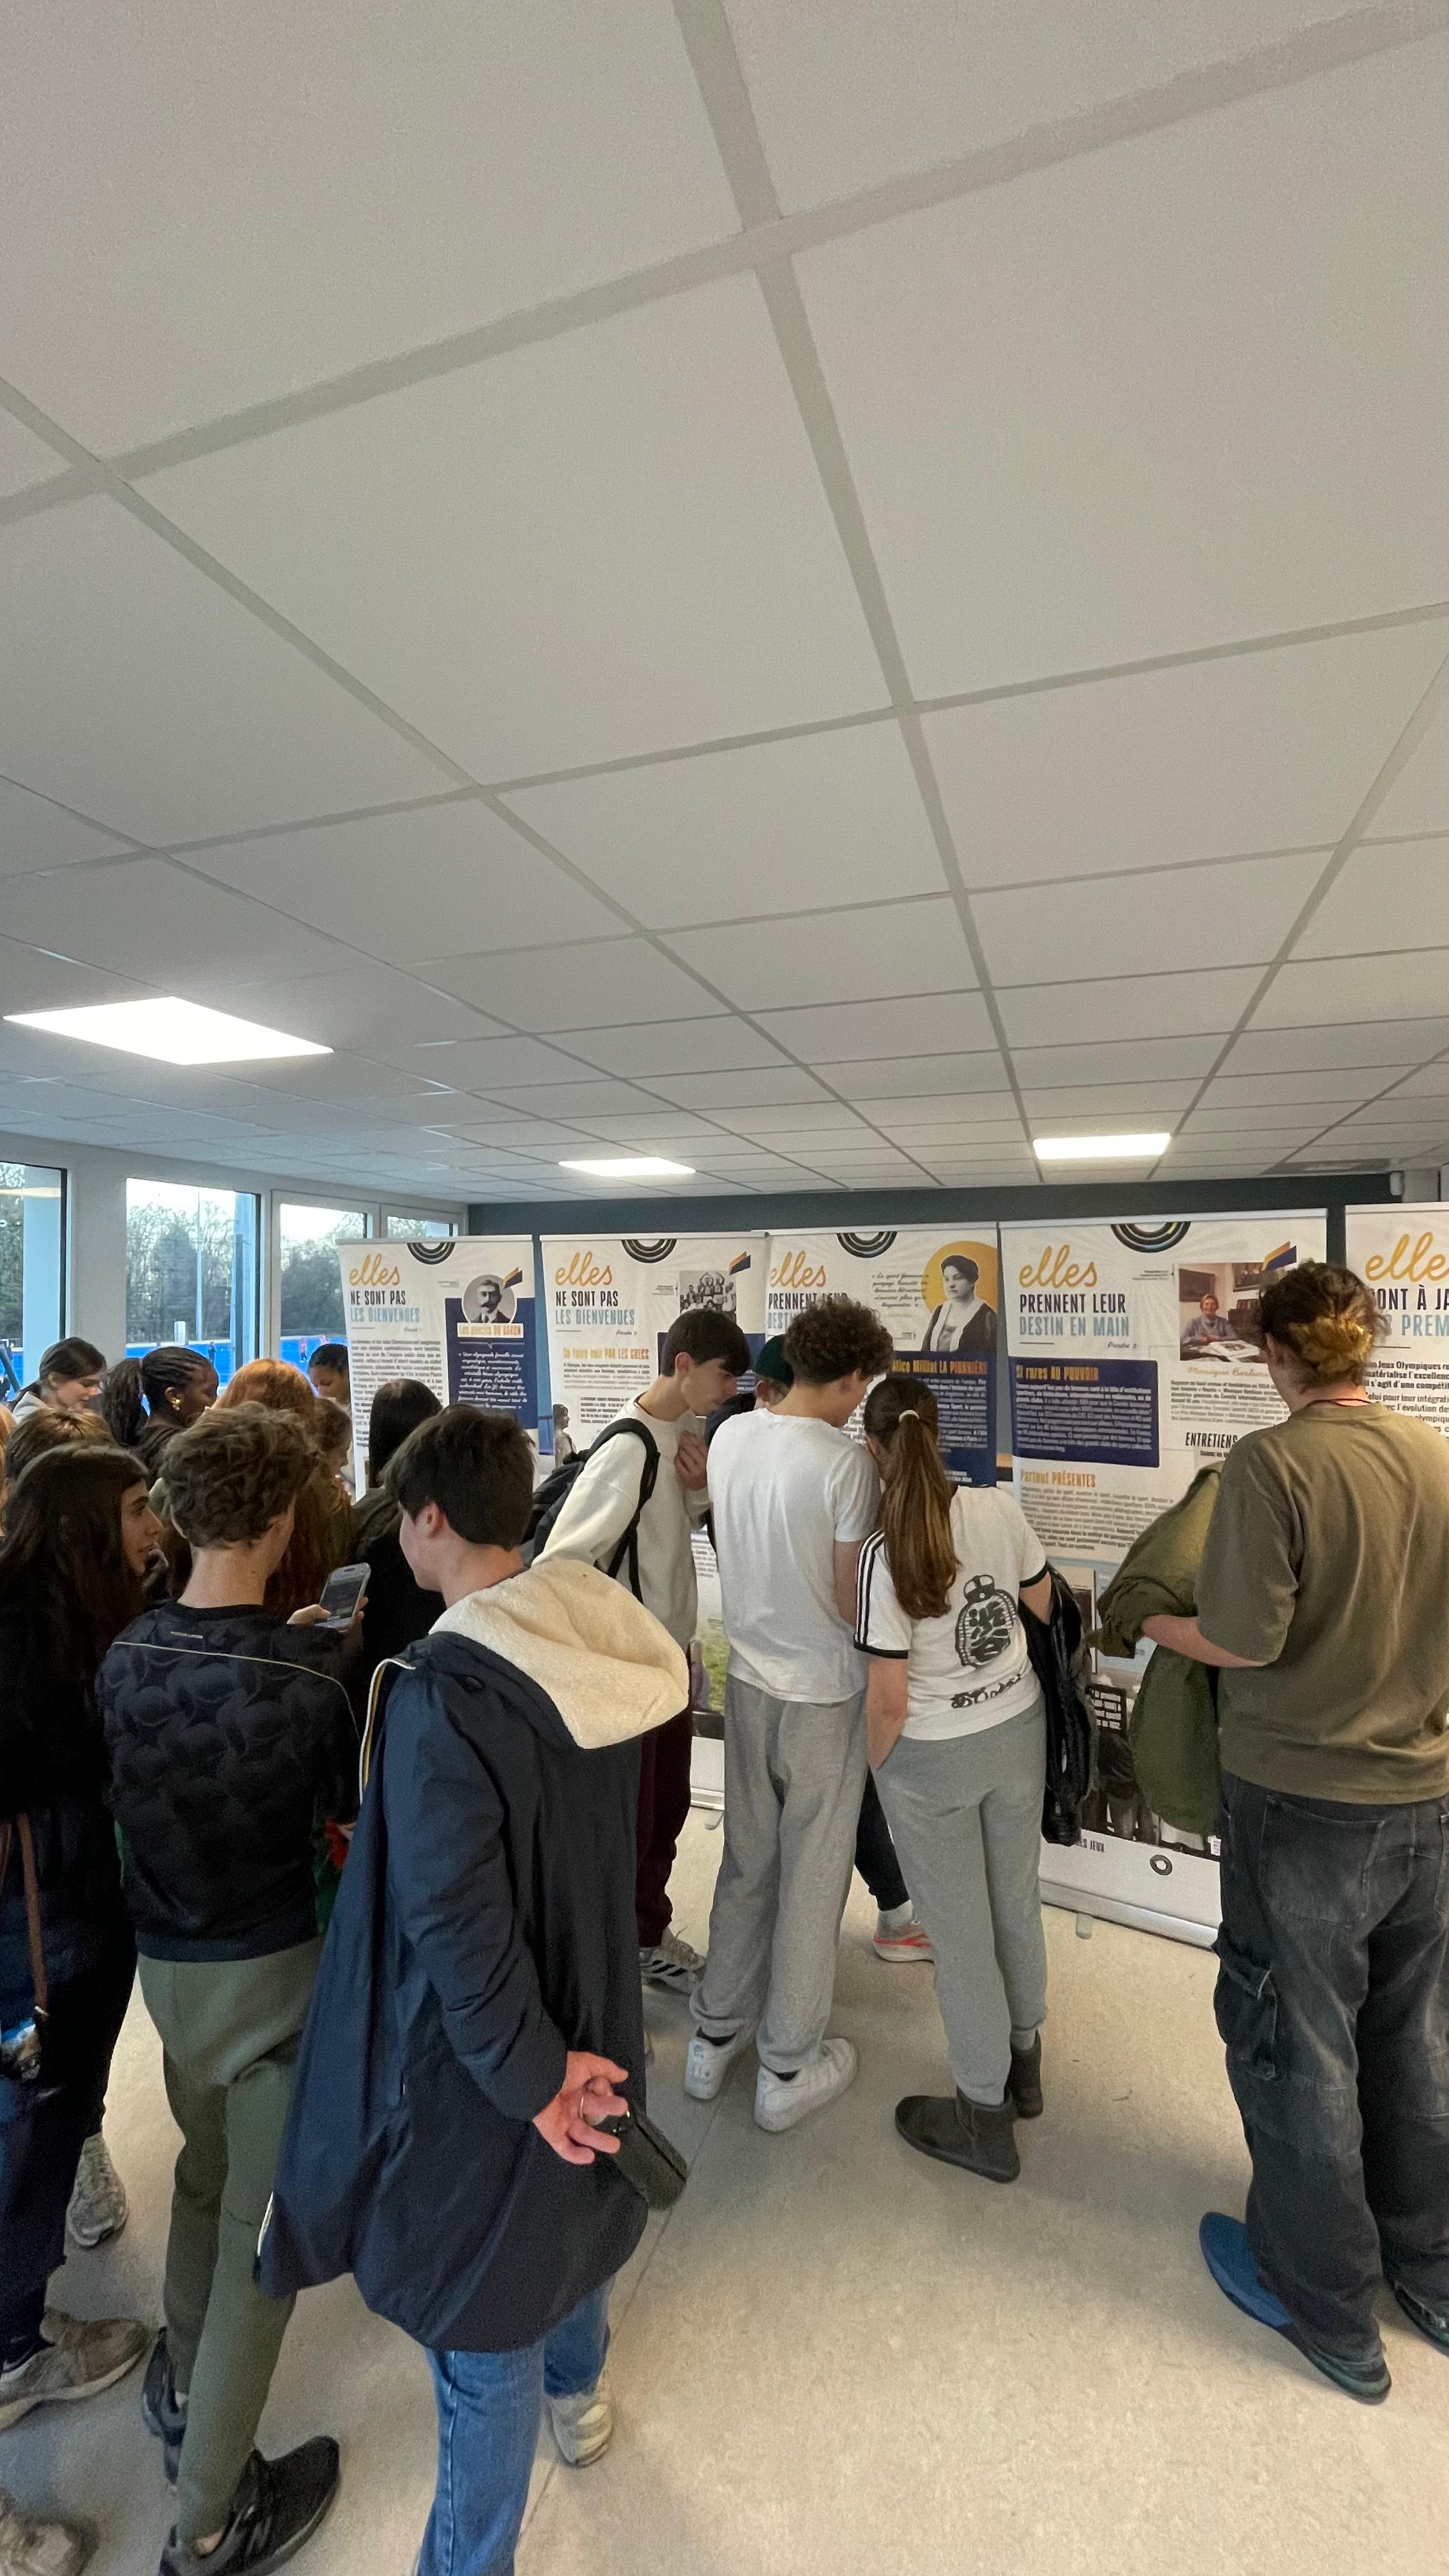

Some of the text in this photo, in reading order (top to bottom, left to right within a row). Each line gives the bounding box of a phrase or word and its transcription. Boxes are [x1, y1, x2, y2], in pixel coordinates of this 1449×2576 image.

[1365, 1232, 1449, 1282] elle
[349, 1254, 401, 1286] elles
[555, 1251, 613, 1287] elles
[770, 1250, 827, 1288] elles
[1019, 1244, 1098, 1289] elles
[350, 1291, 406, 1305] NE SONT PAS
[556, 1291, 618, 1307] NE SONT PAS
[1020, 1293, 1126, 1314] PRENNENT LEUR
[1417, 1284, 1427, 1310] À
[351, 1308, 420, 1322] LES BIENVENUES
[556, 1310, 634, 1326] LES BIENVENUES
[1020, 1317, 1129, 1337] DESTIN EN MAIN
[604, 1348, 616, 1360] PAR
[618, 1348, 628, 1360] LES
[630, 1348, 649, 1360] GRECS
[939, 1360, 947, 1373] LA
[1025, 1367, 1048, 1379] rares
[1050, 1366, 1061, 1380] AU
[1063, 1367, 1100, 1381] POUVOIR
[1396, 1361, 1441, 1371] Olympiques
[1185, 1432, 1239, 1448] ENTRETIENS
[1051, 1469, 1096, 1488] PRÉSENTES
